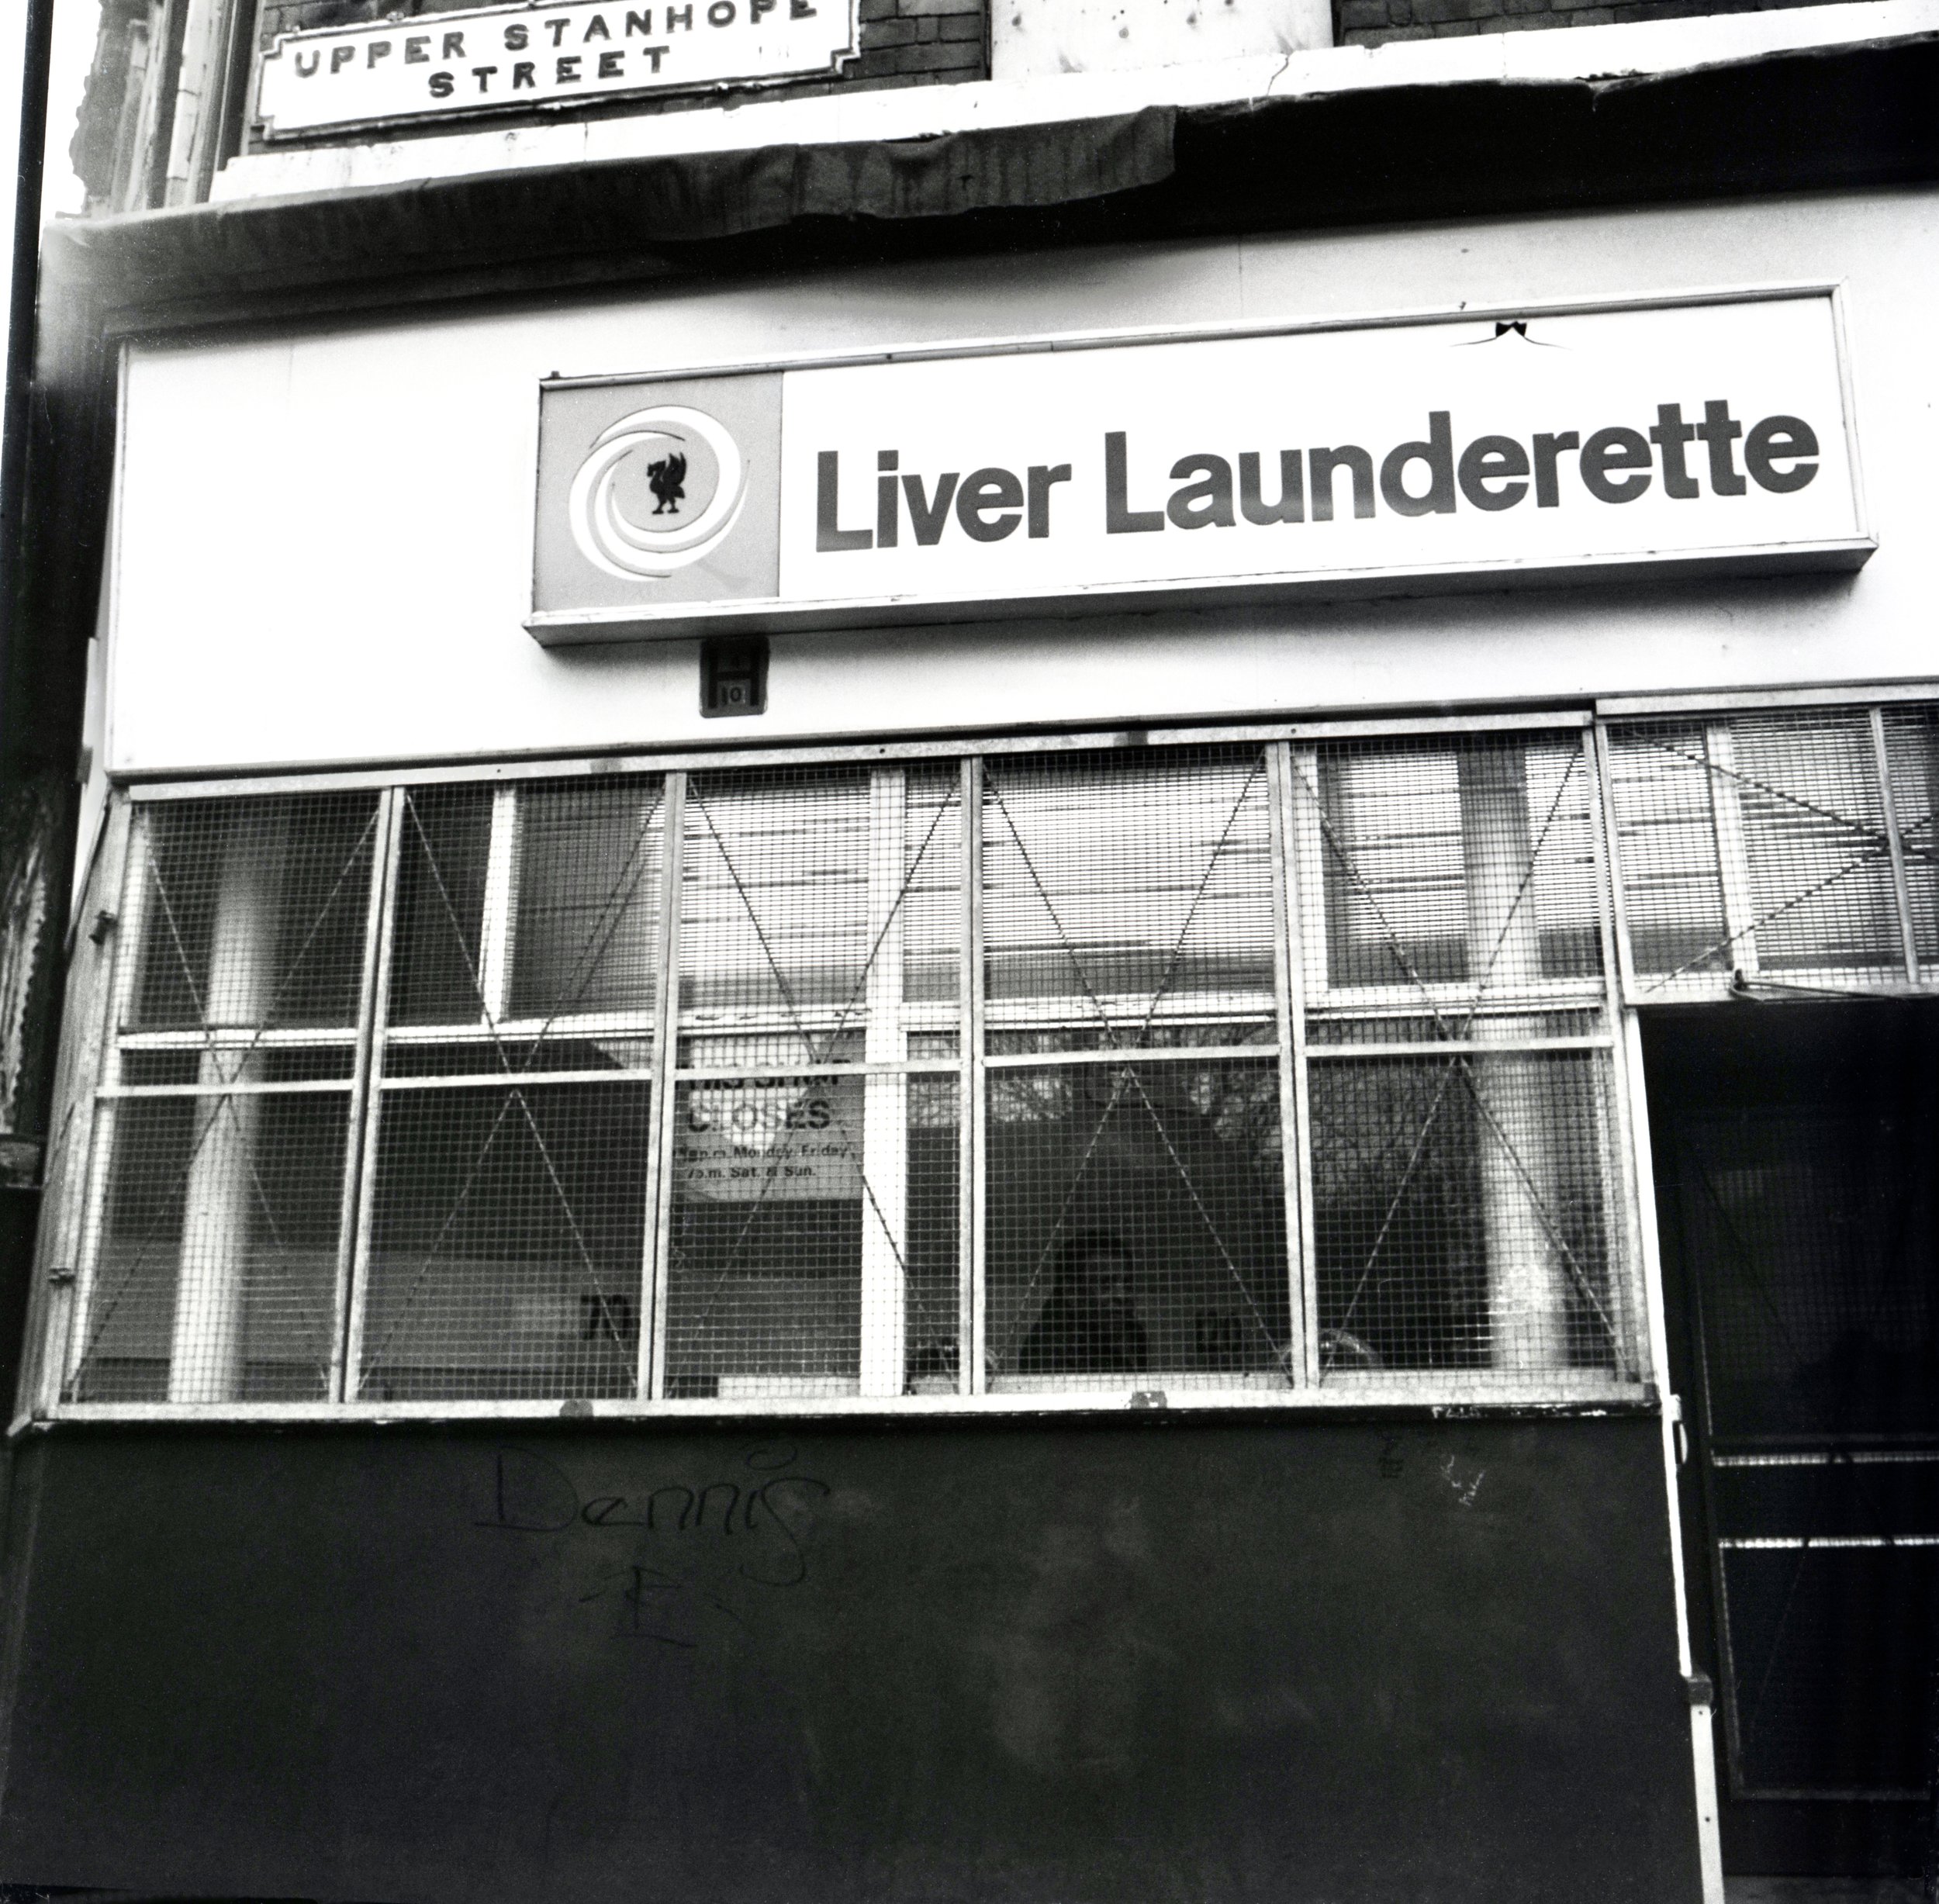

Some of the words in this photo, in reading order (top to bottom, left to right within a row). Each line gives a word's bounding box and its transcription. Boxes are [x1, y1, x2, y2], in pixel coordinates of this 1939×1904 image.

[295, 31, 466, 78] UPPER
[503, 0, 817, 51] STANHOPE
[428, 45, 670, 98] STREET
[815, 448, 1073, 553] Liver
[1104, 399, 1820, 534] Launderette
